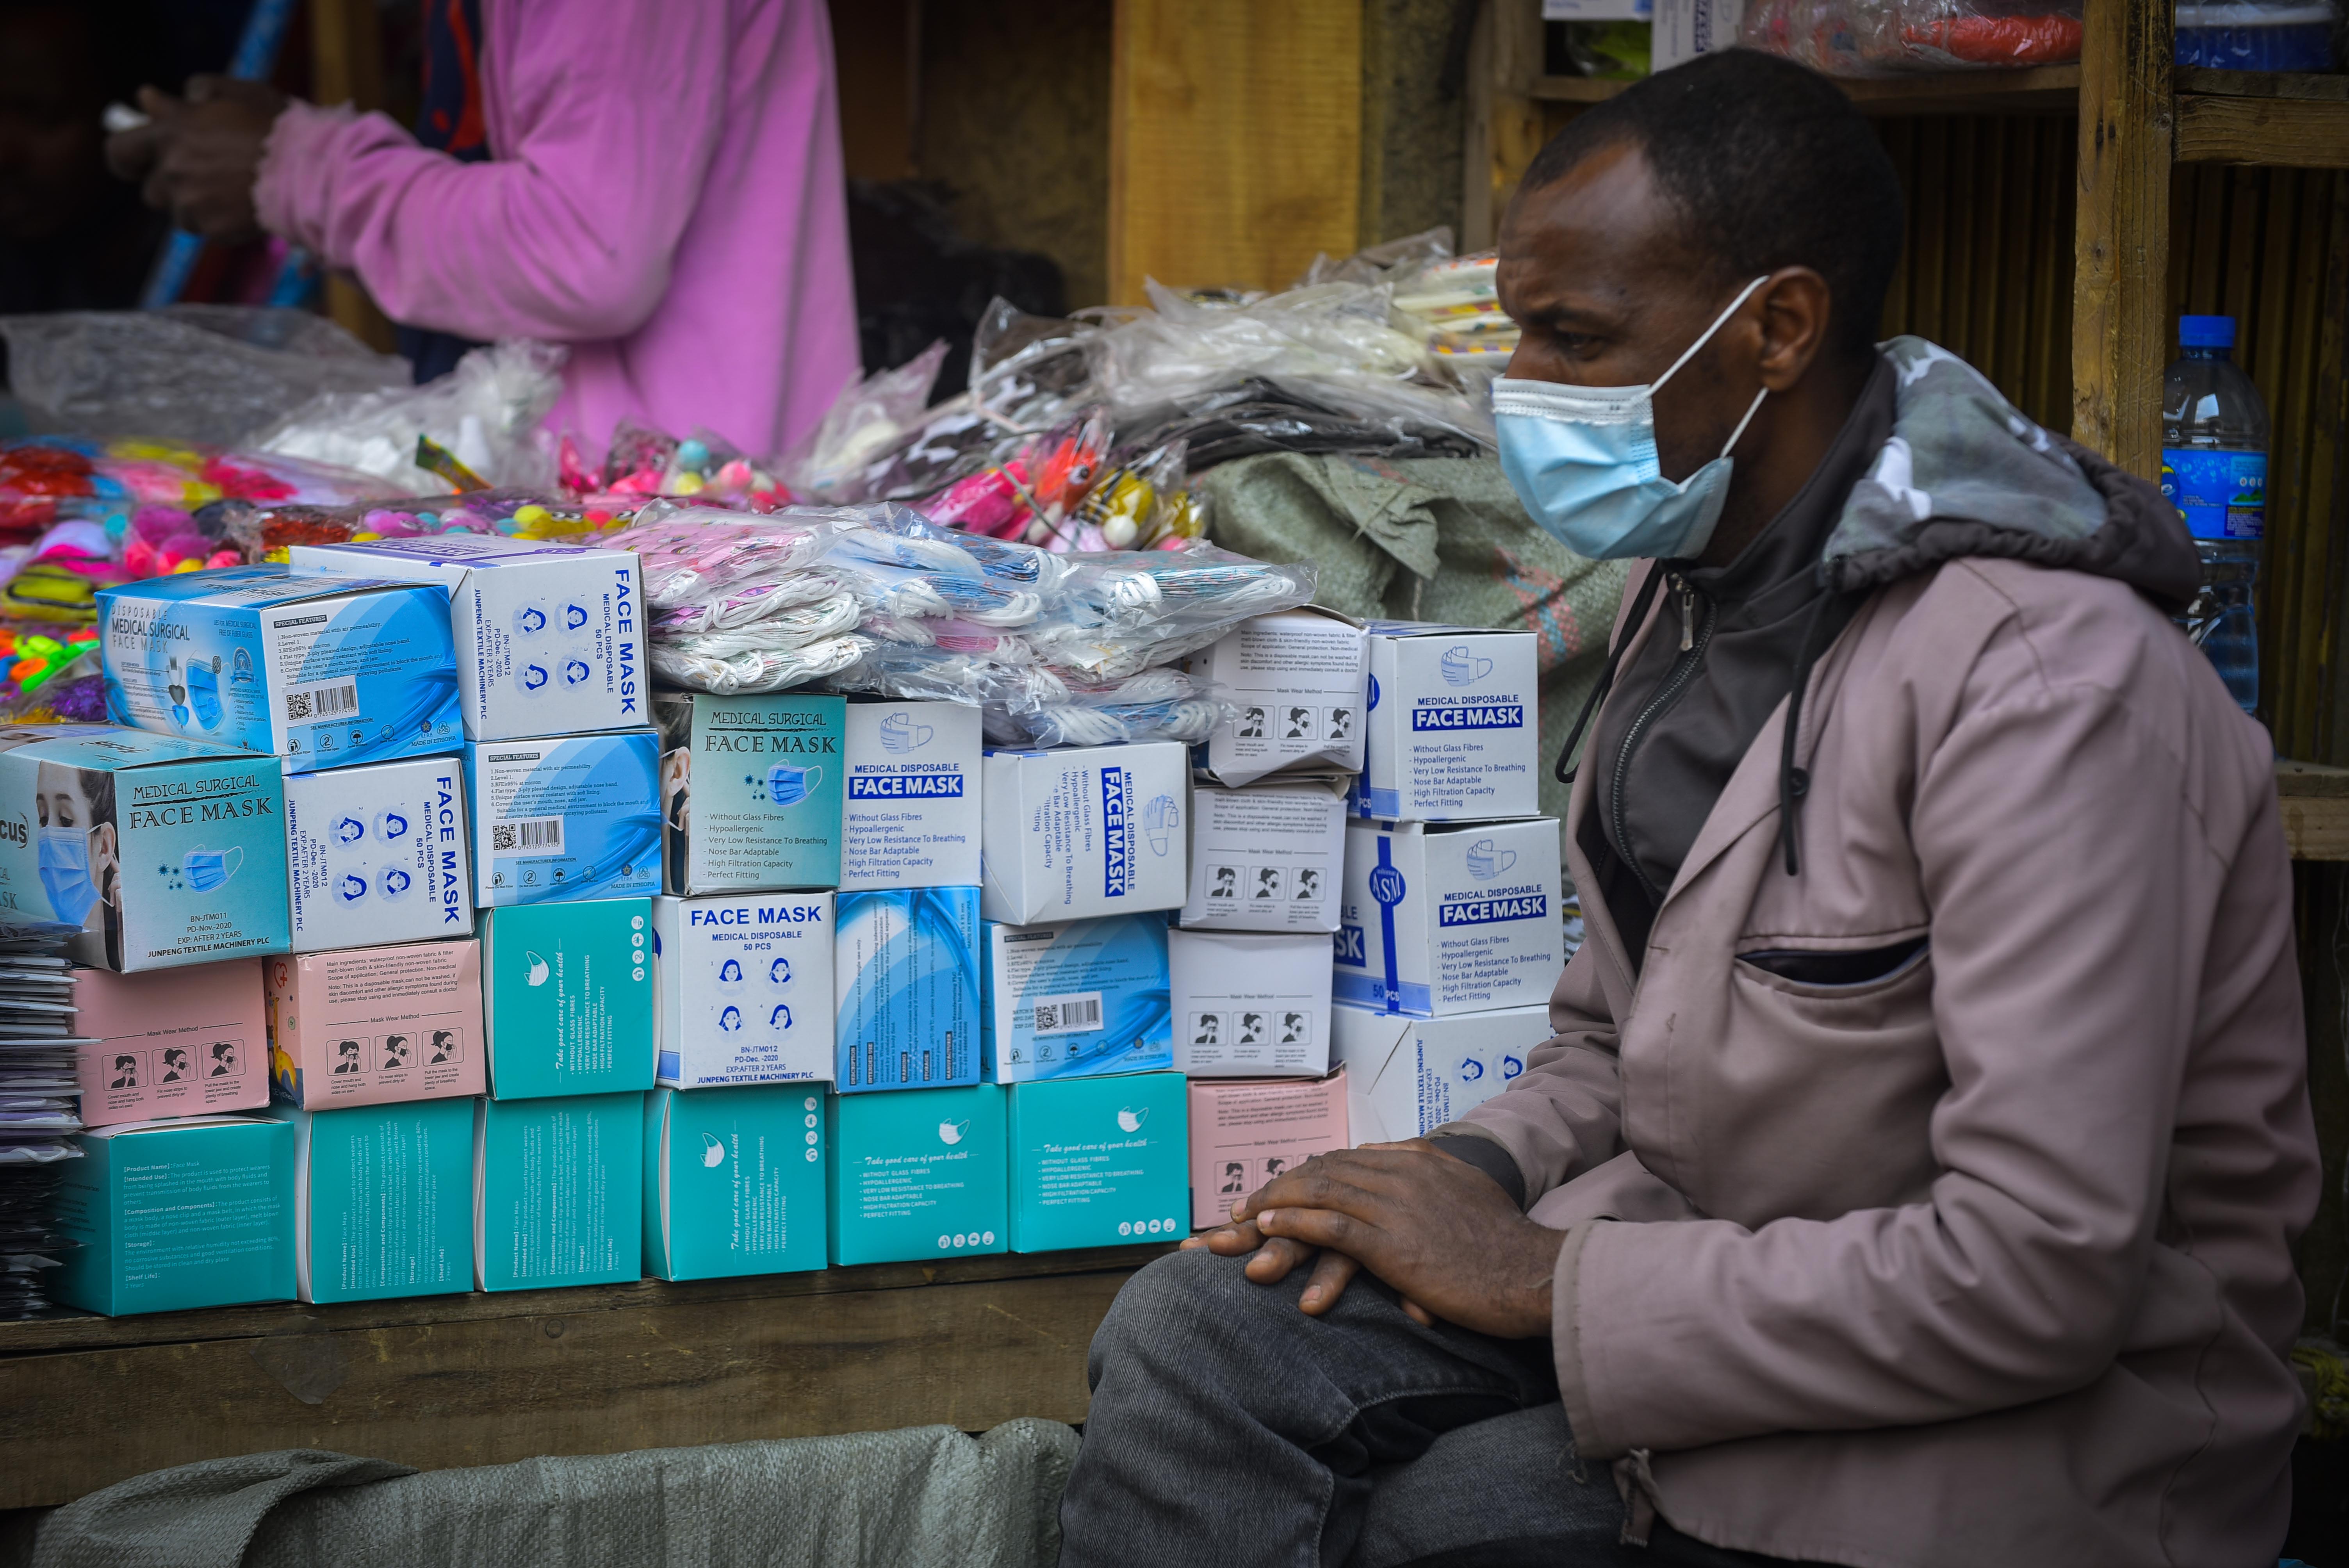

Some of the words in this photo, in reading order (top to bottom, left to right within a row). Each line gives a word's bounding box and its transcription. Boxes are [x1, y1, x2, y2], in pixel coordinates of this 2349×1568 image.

[615, 570, 632, 633] FACE
[111, 603, 167, 622] DISPOSABLE
[112, 618, 147, 636] MEDICAL
[149, 622, 189, 640] SURGICAL
[595, 629, 601, 638] 50
[113, 634, 135, 649] FACE
[141, 638, 168, 653] MASK
[605, 636, 613, 693] DISPOSABLE
[620, 643, 635, 714] MASK
[1418, 697, 1459, 705] MEDICAL
[1462, 695, 1518, 704] DISPOSABLE
[711, 712, 765, 724] MEDICAL
[768, 713, 826, 725] SURGICAL
[1417, 710, 1463, 727] FACE
[1467, 707, 1520, 725] MASK
[705, 736, 764, 752] FACE
[771, 736, 835, 753] MASK
[901, 763, 959, 772] DISPOSABLE
[134, 782, 192, 799] MEDICAL
[196, 775, 259, 794] SURGICAL
[854, 778, 902, 795] FACE
[906, 777, 960, 794] MASK
[1105, 772, 1122, 827] FACE
[1125, 772, 1134, 819] MEDICAL
[1441, 799, 1462, 807] Fitting
[129, 806, 193, 829] FACE
[200, 797, 273, 821] MASK
[437, 777, 454, 842] FACE
[424, 802, 432, 842] MEDICAL
[709, 825, 763, 834] Hypoallergenic
[849, 825, 904, 834] Hypoallergenic
[416, 838, 422, 847] 50
[709, 837, 725, 845] Very
[795, 837, 827, 846] Breathing
[743, 848, 779, 857] Adaptable
[708, 859, 725, 868] High
[763, 860, 793, 868] Capacity
[1109, 830, 1125, 896] MASK
[427, 845, 436, 902] DISPOSABLE
[736, 871, 759, 880] Fitting
[442, 851, 459, 923] MASK
[1372, 872, 1401, 902] ASM
[1444, 891, 1485, 901] MEDICAL
[1488, 884, 1541, 897] DISPOSABLE
[191, 912, 226, 922] BN-JTM011
[692, 909, 749, 926] FACE
[759, 906, 821, 923] MASK
[1444, 903, 1490, 922] FACE
[1493, 897, 1543, 918] MASK
[193, 934, 214, 942] AFTER
[221, 930, 242, 939] YEARS
[751, 931, 801, 939] DISPOSABLE
[148, 948, 182, 957] JUNPENG
[183, 944, 211, 953] TEXTILE
[214, 939, 255, 950] MACHINERY
[1373, 985, 1384, 998] 50
[1386, 990, 1399, 1002] PCS
[1443, 984, 1459, 993] High
[1461, 981, 1491, 990] Filtration
[1493, 978, 1521, 987] Capacity
[557, 1028, 565, 1046] good
[865, 1156, 883, 1165] Take
[885, 1156, 902, 1166] good
[920, 1155, 927, 1164] of
[945, 1151, 967, 1159] health
